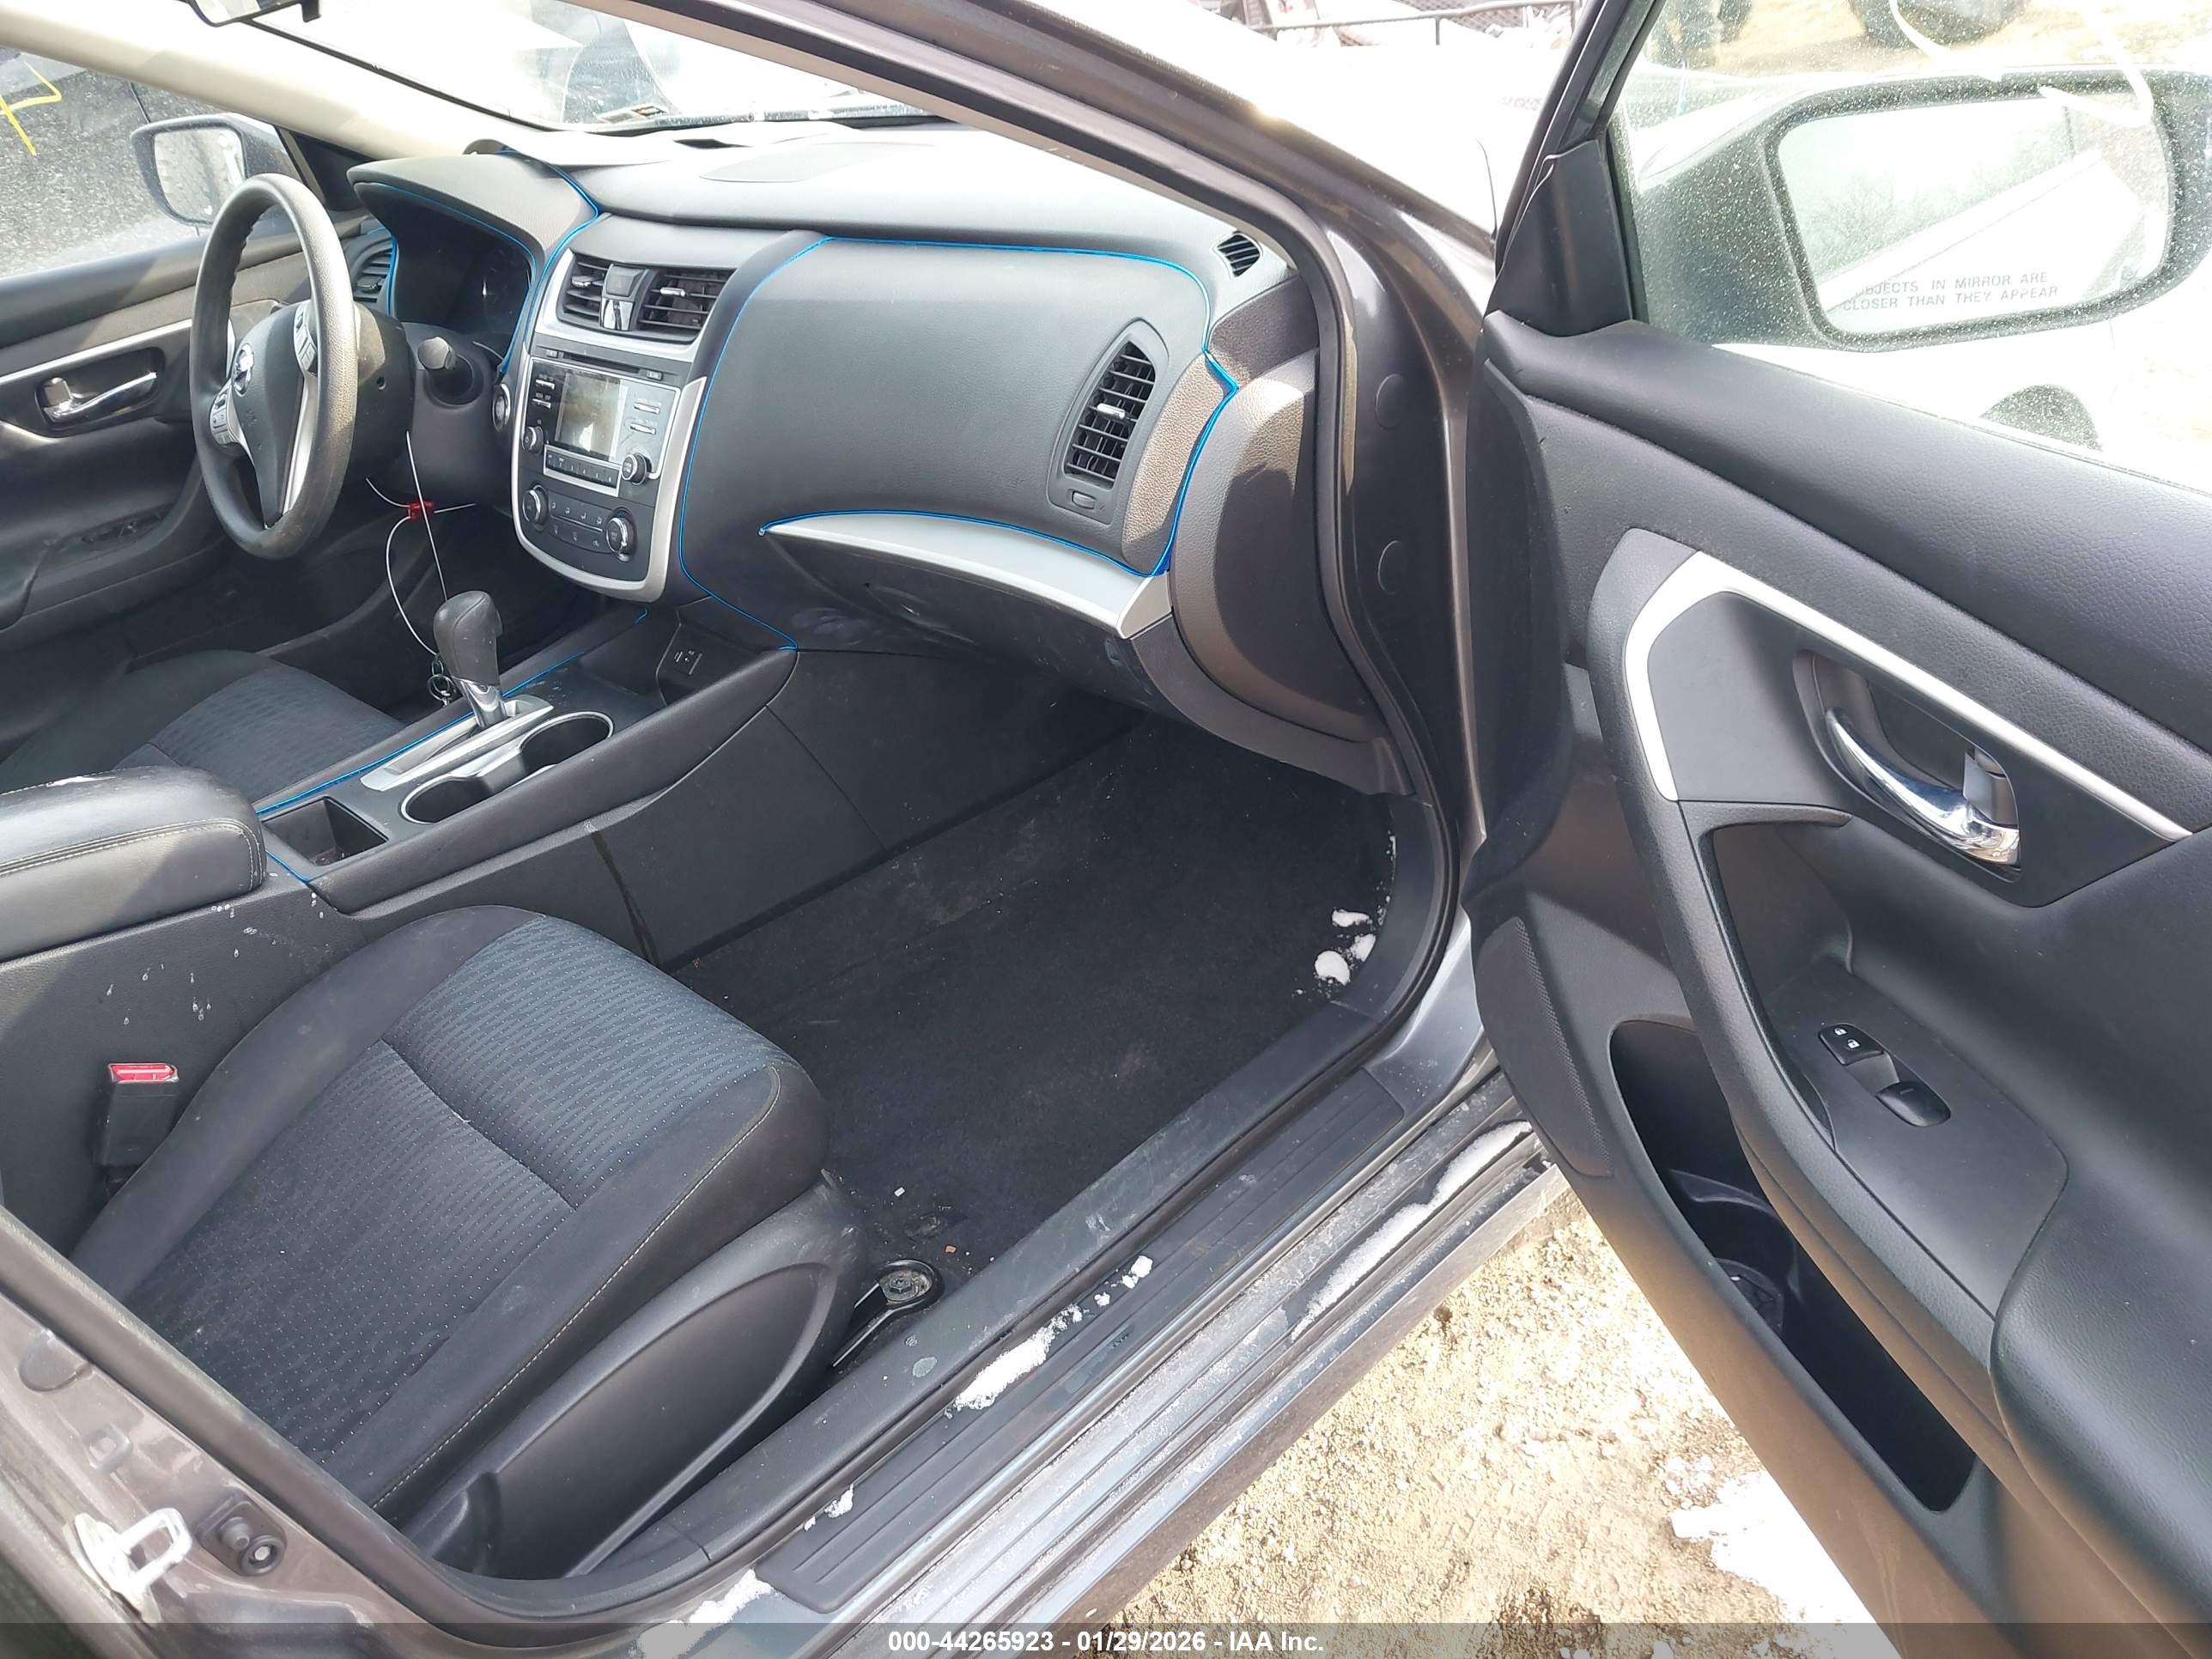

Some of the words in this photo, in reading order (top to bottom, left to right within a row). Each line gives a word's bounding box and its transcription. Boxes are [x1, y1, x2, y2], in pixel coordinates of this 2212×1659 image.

[1931, 280, 1946, 290] IN
[1955, 275, 2010, 289] MIRROR
[2021, 272, 2048, 283] ARE
[1844, 296, 1898, 311] CLOSER
[1910, 295, 1945, 307] THAN
[1957, 292, 1991, 304] THEY
[2001, 286, 2057, 301] APPEAR
